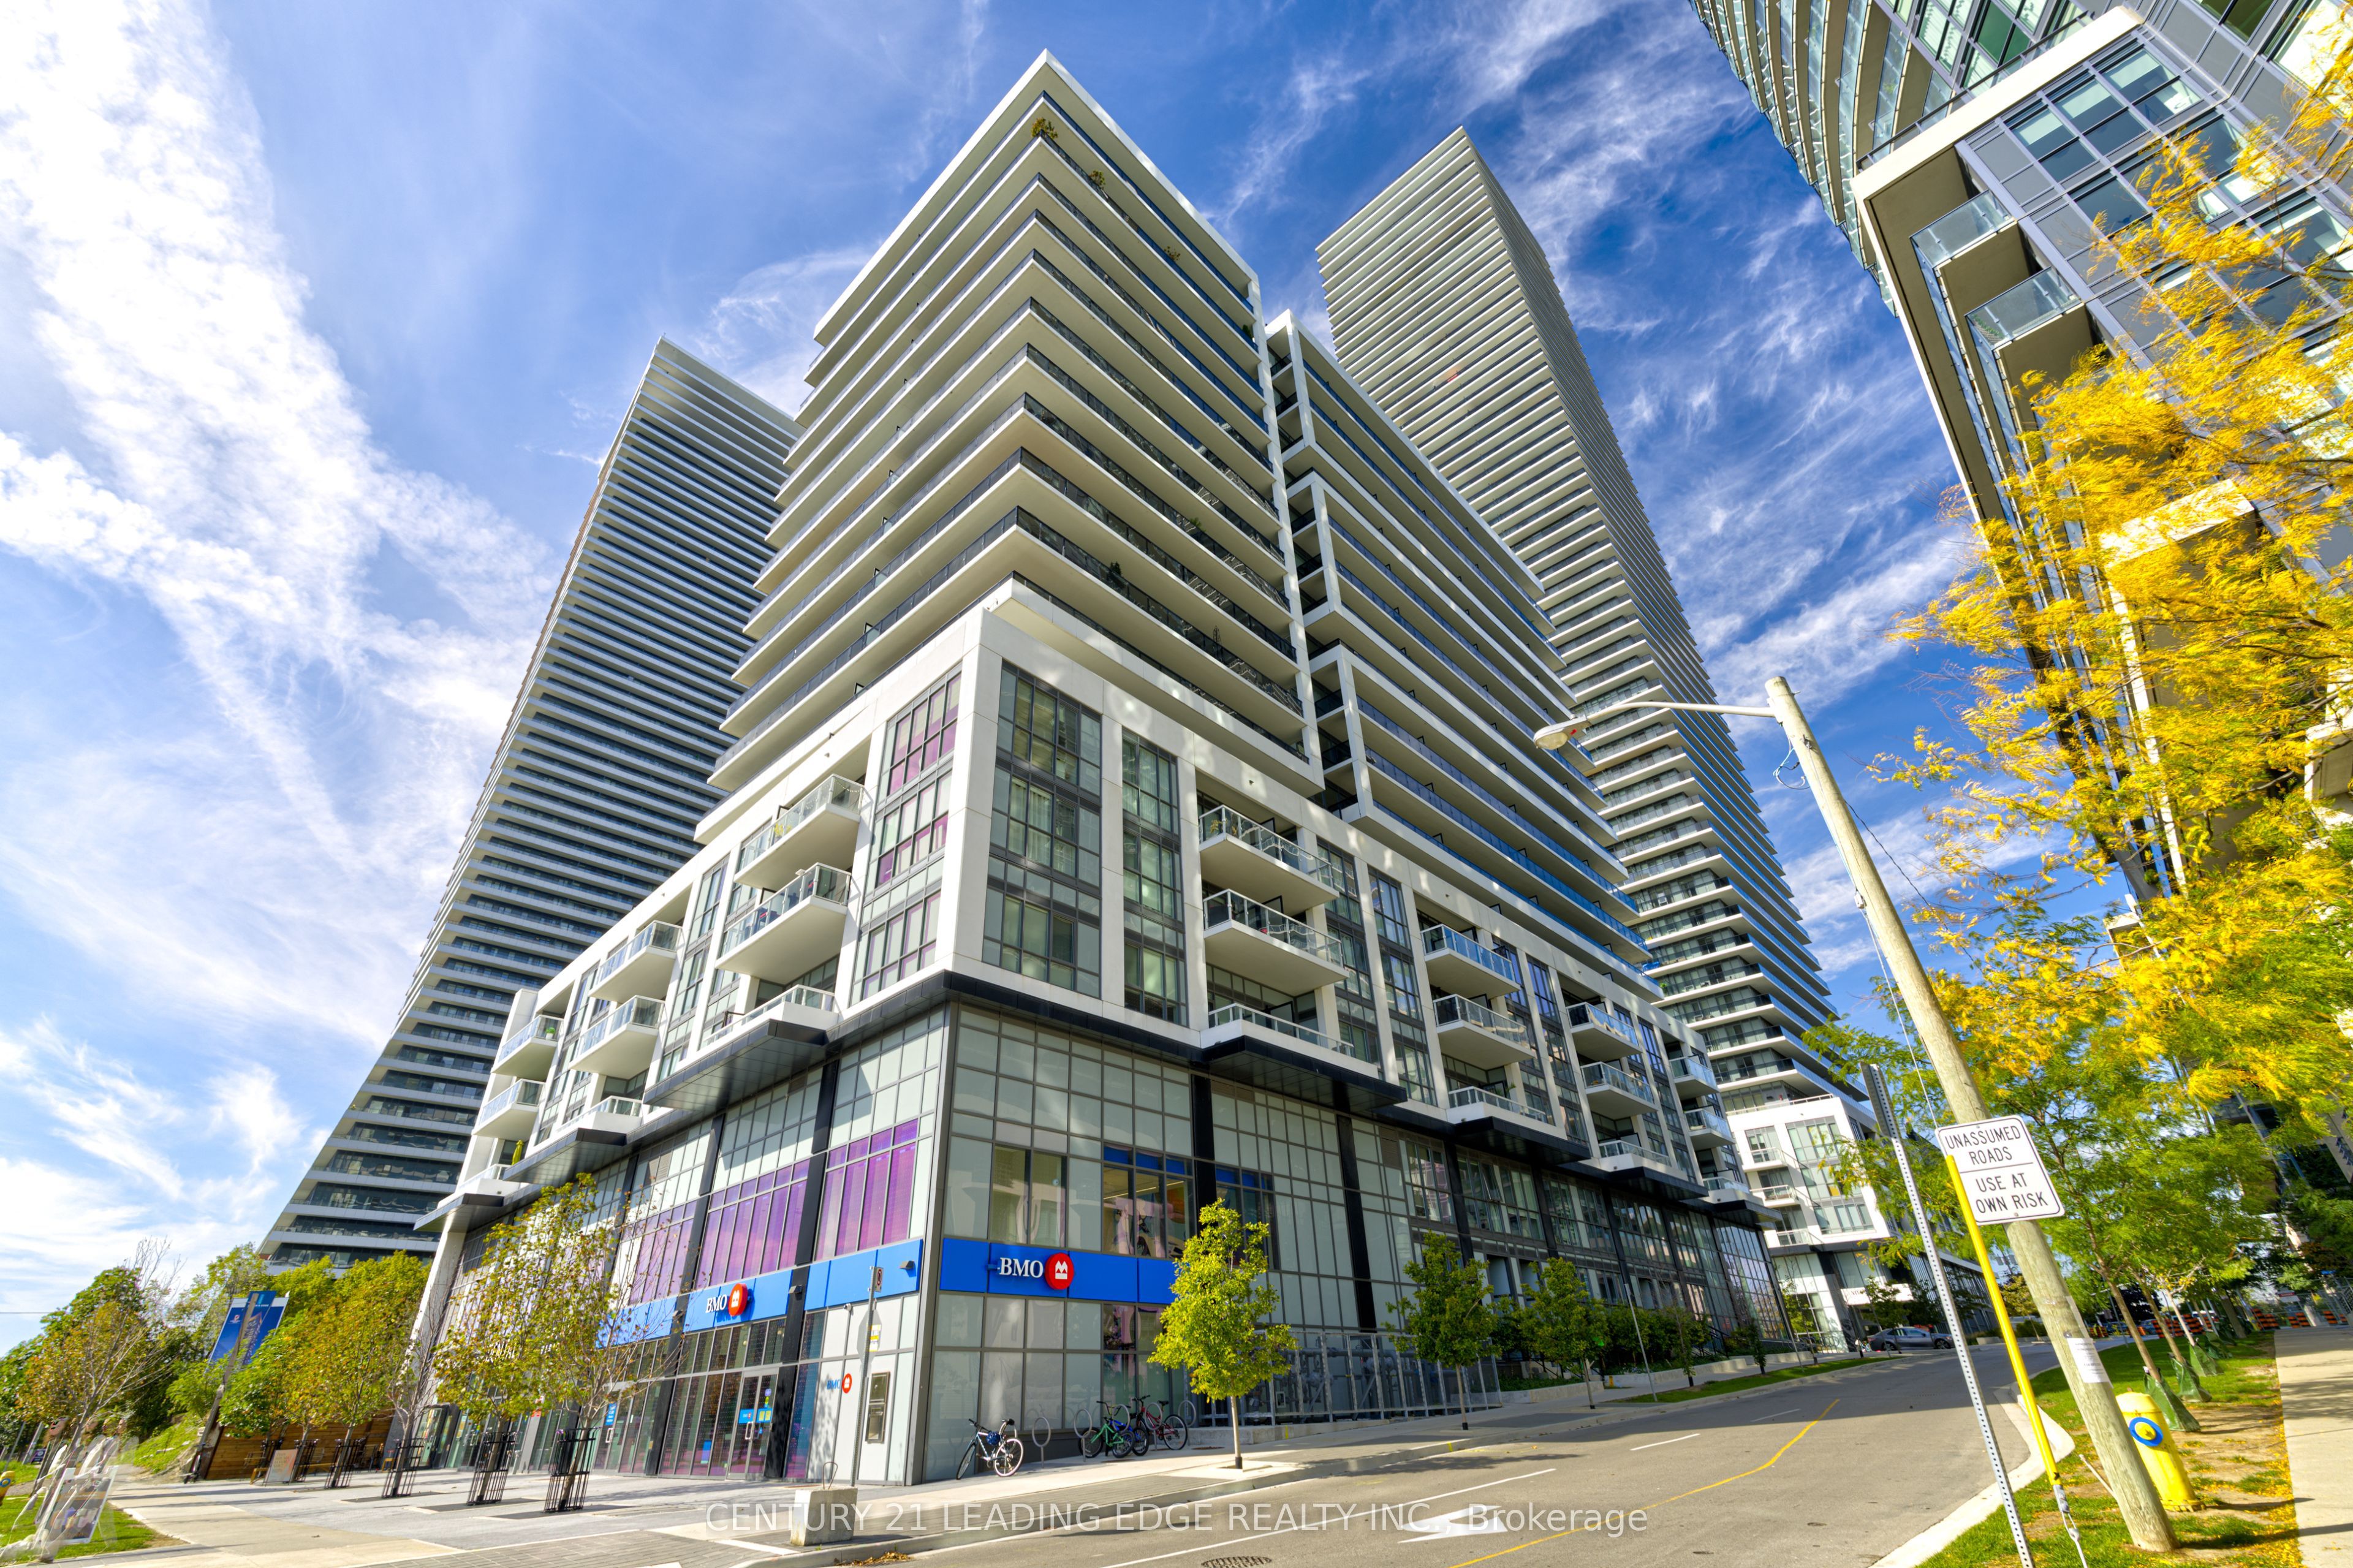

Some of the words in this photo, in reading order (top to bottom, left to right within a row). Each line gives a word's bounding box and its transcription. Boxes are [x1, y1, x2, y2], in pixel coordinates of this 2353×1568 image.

[1945, 1126, 2021, 1149] UNASSUMED
[1968, 1146, 2013, 1165] ROADS
[1976, 1176, 2007, 1193] USE
[2011, 1173, 2028, 1188] AT
[1976, 1196, 2009, 1214] OWN
[2011, 1192, 2048, 1210] RISK
[999, 1257, 1044, 1278] BMO
[705, 1294, 727, 1313] BMO
[827, 1379, 842, 1390] BMO
